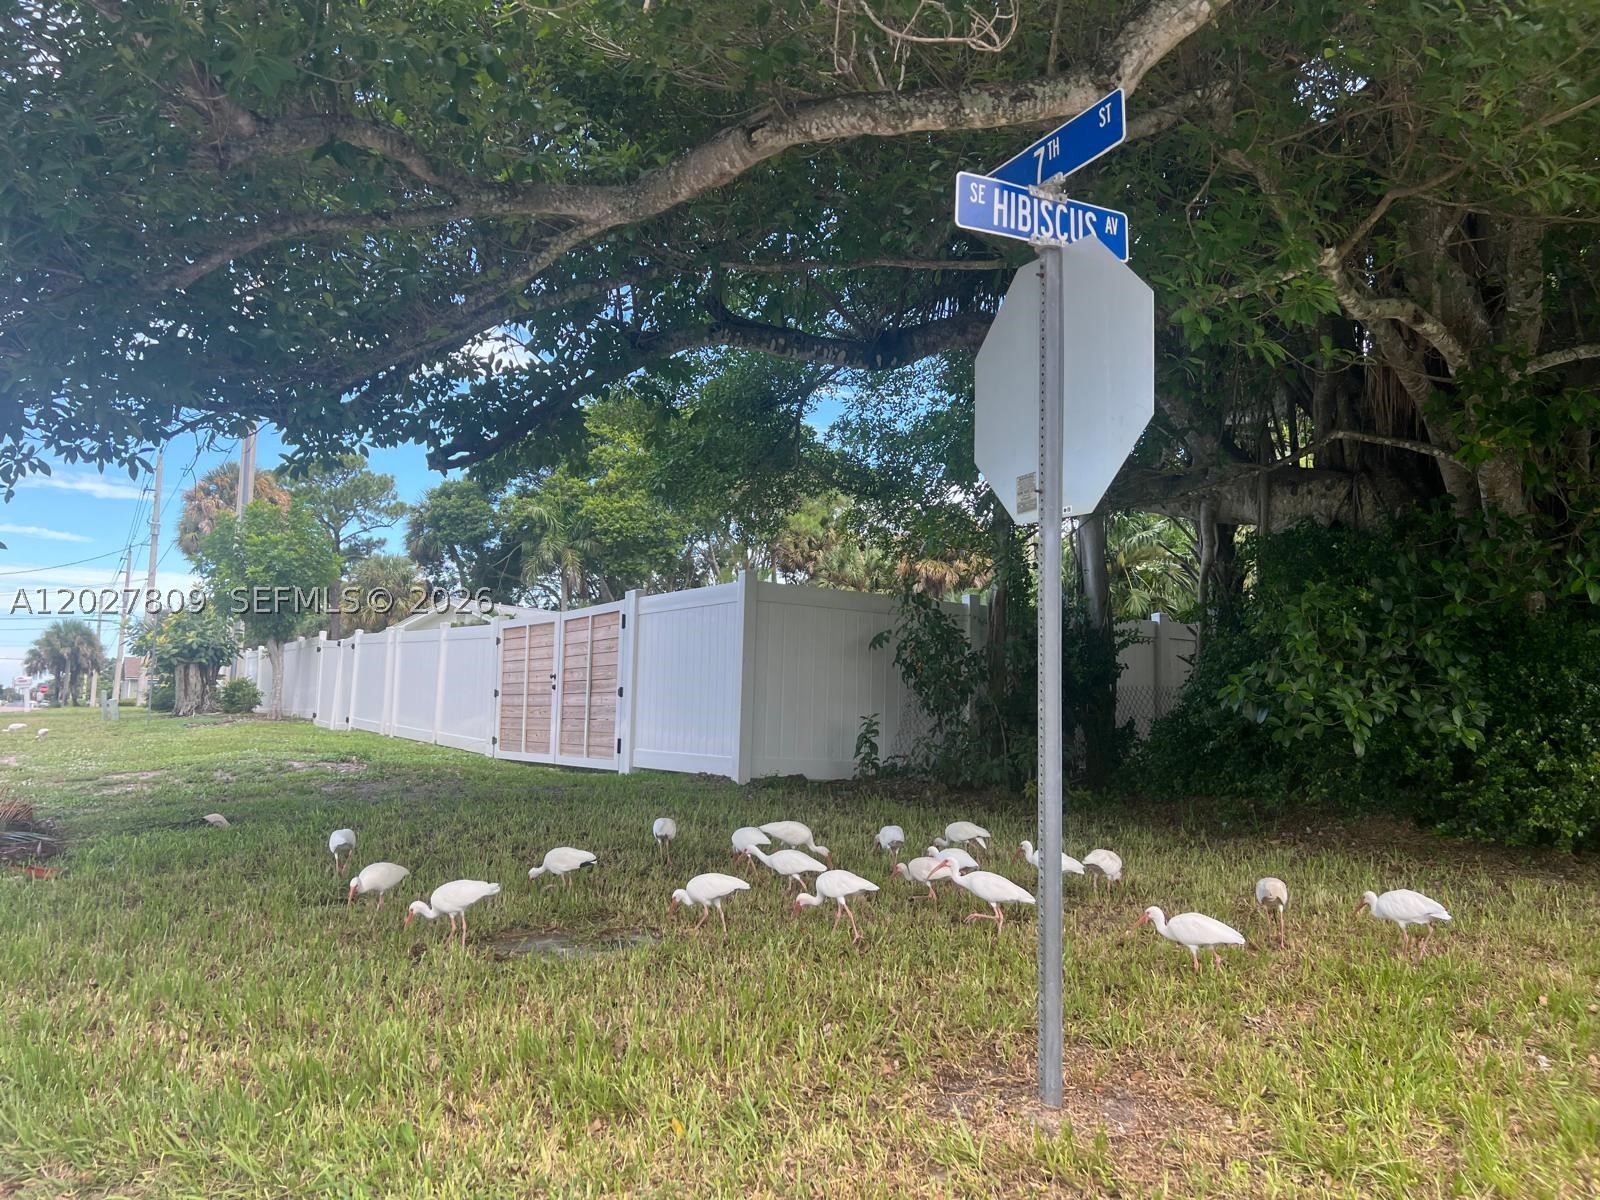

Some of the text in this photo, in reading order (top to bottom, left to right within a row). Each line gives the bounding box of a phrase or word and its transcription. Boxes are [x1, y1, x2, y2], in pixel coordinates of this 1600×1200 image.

[1033, 103, 1112, 185] 7TH ST
[970, 182, 1118, 242] SE HIBISCUS AV
